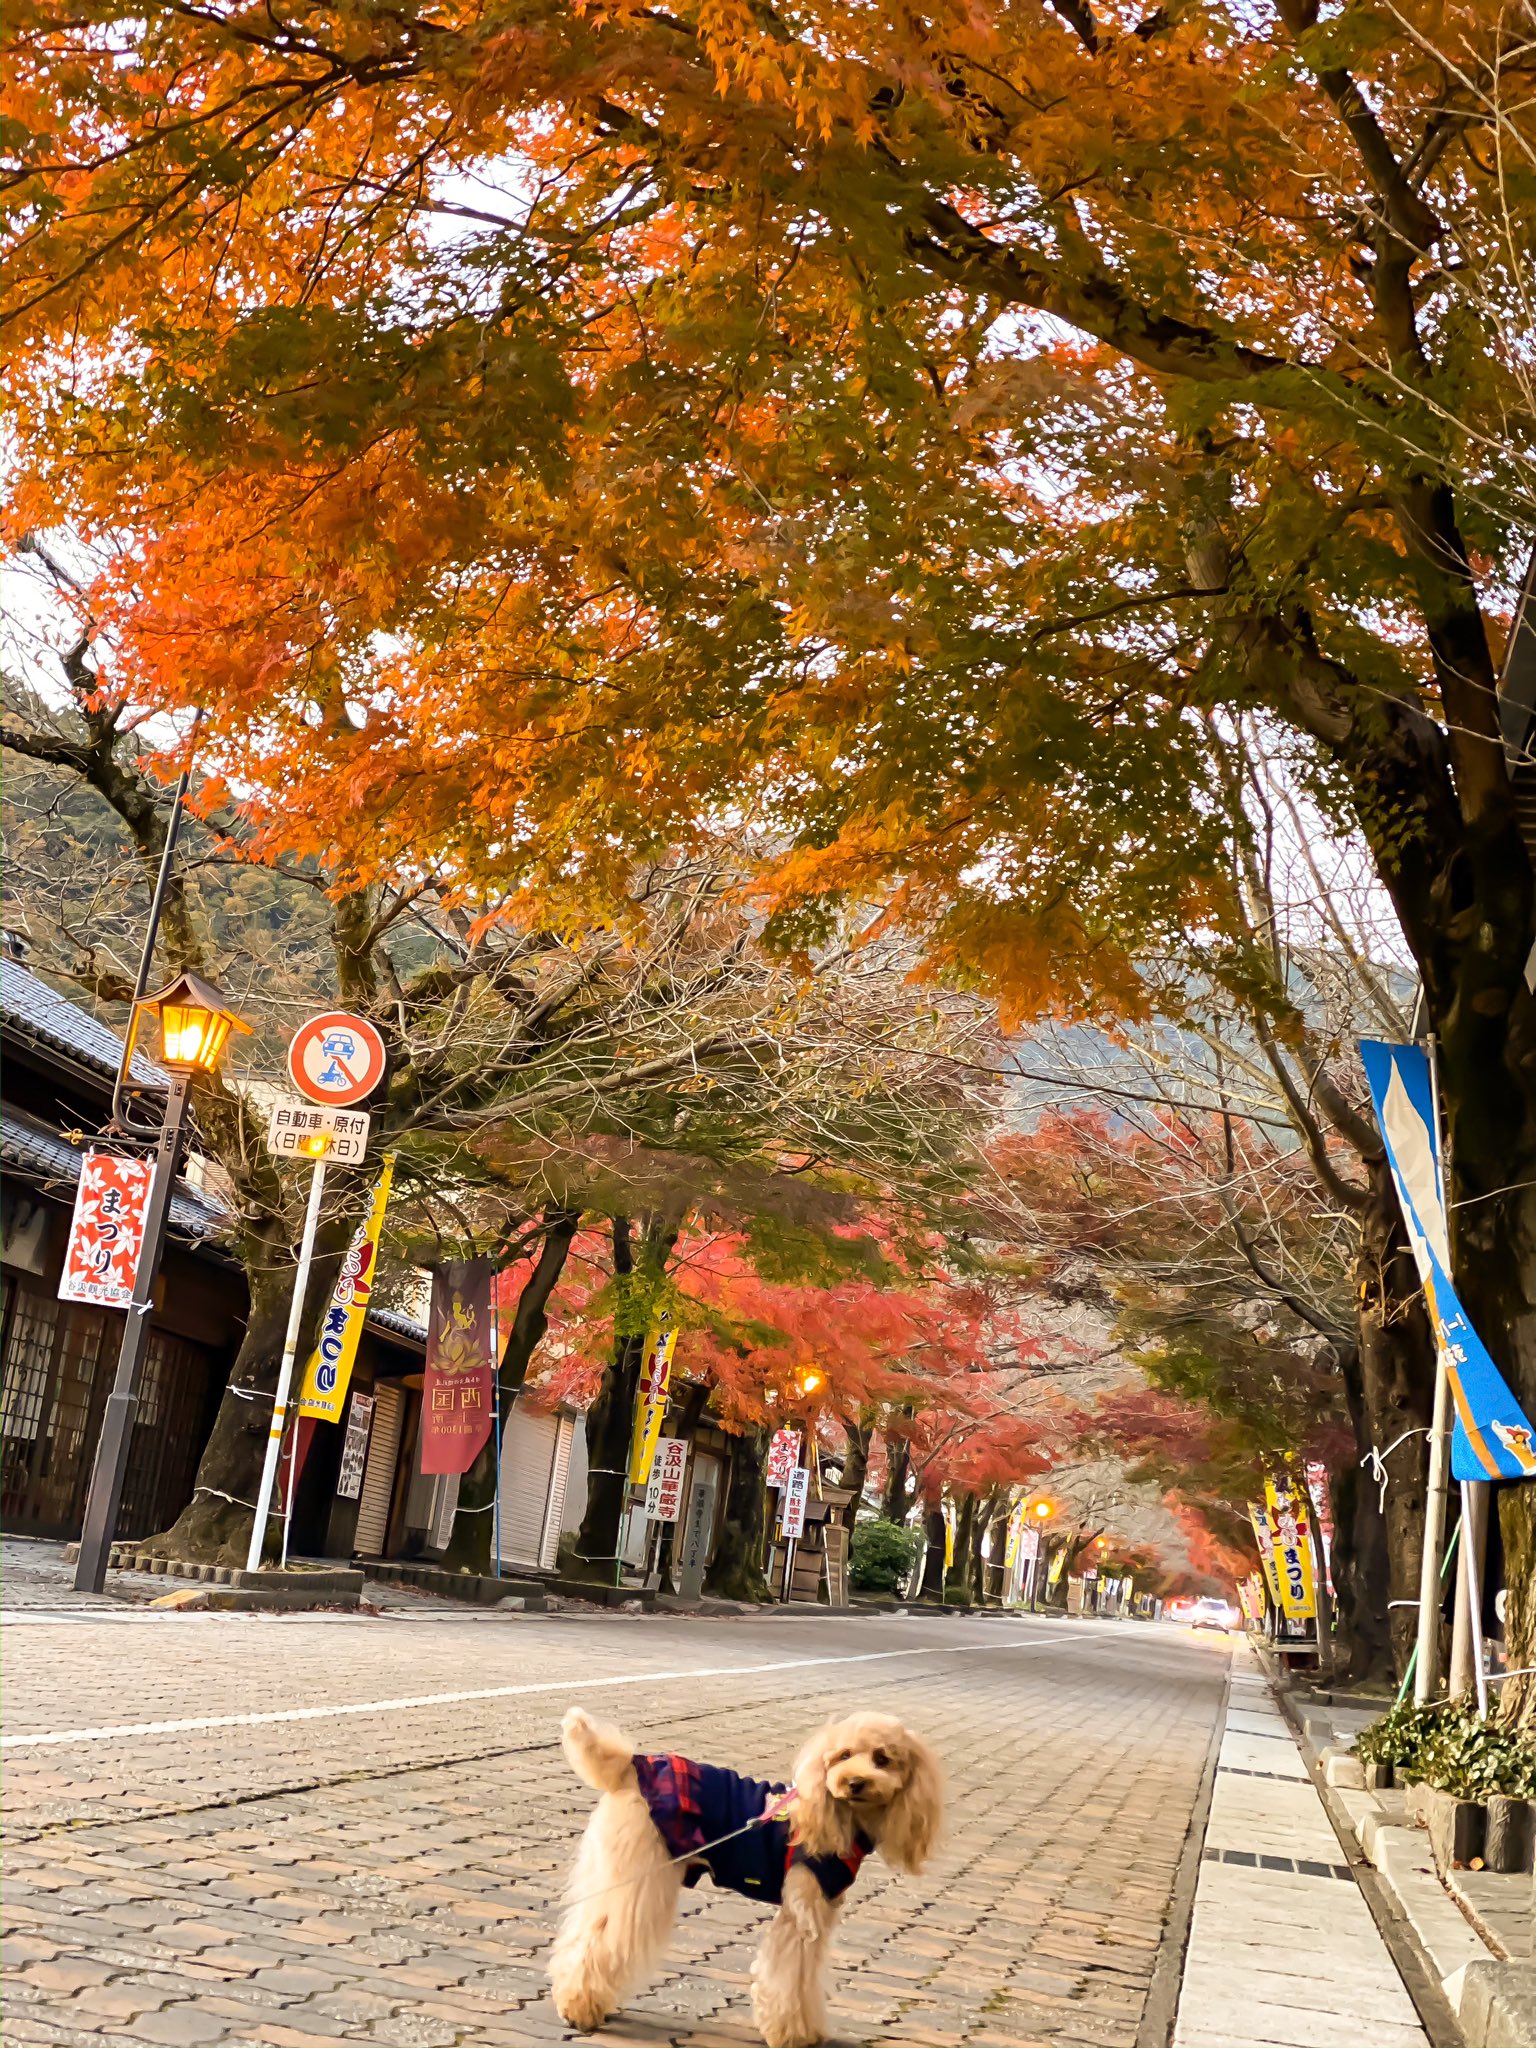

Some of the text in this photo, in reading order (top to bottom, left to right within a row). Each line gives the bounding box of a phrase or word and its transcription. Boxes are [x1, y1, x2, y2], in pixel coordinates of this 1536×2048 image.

[274, 1131, 359, 1158] （日曜休日）
[276, 1110, 365, 1135] 自動車・原付
[95, 1189, 121, 1275] まつり
[647, 1454, 662, 1514] 徒歩10分
[658, 1442, 684, 1519] 谷汲山華厳寺
[779, 1442, 789, 1475] まつり
[785, 1470, 806, 1536] 道路に駐車禁止
